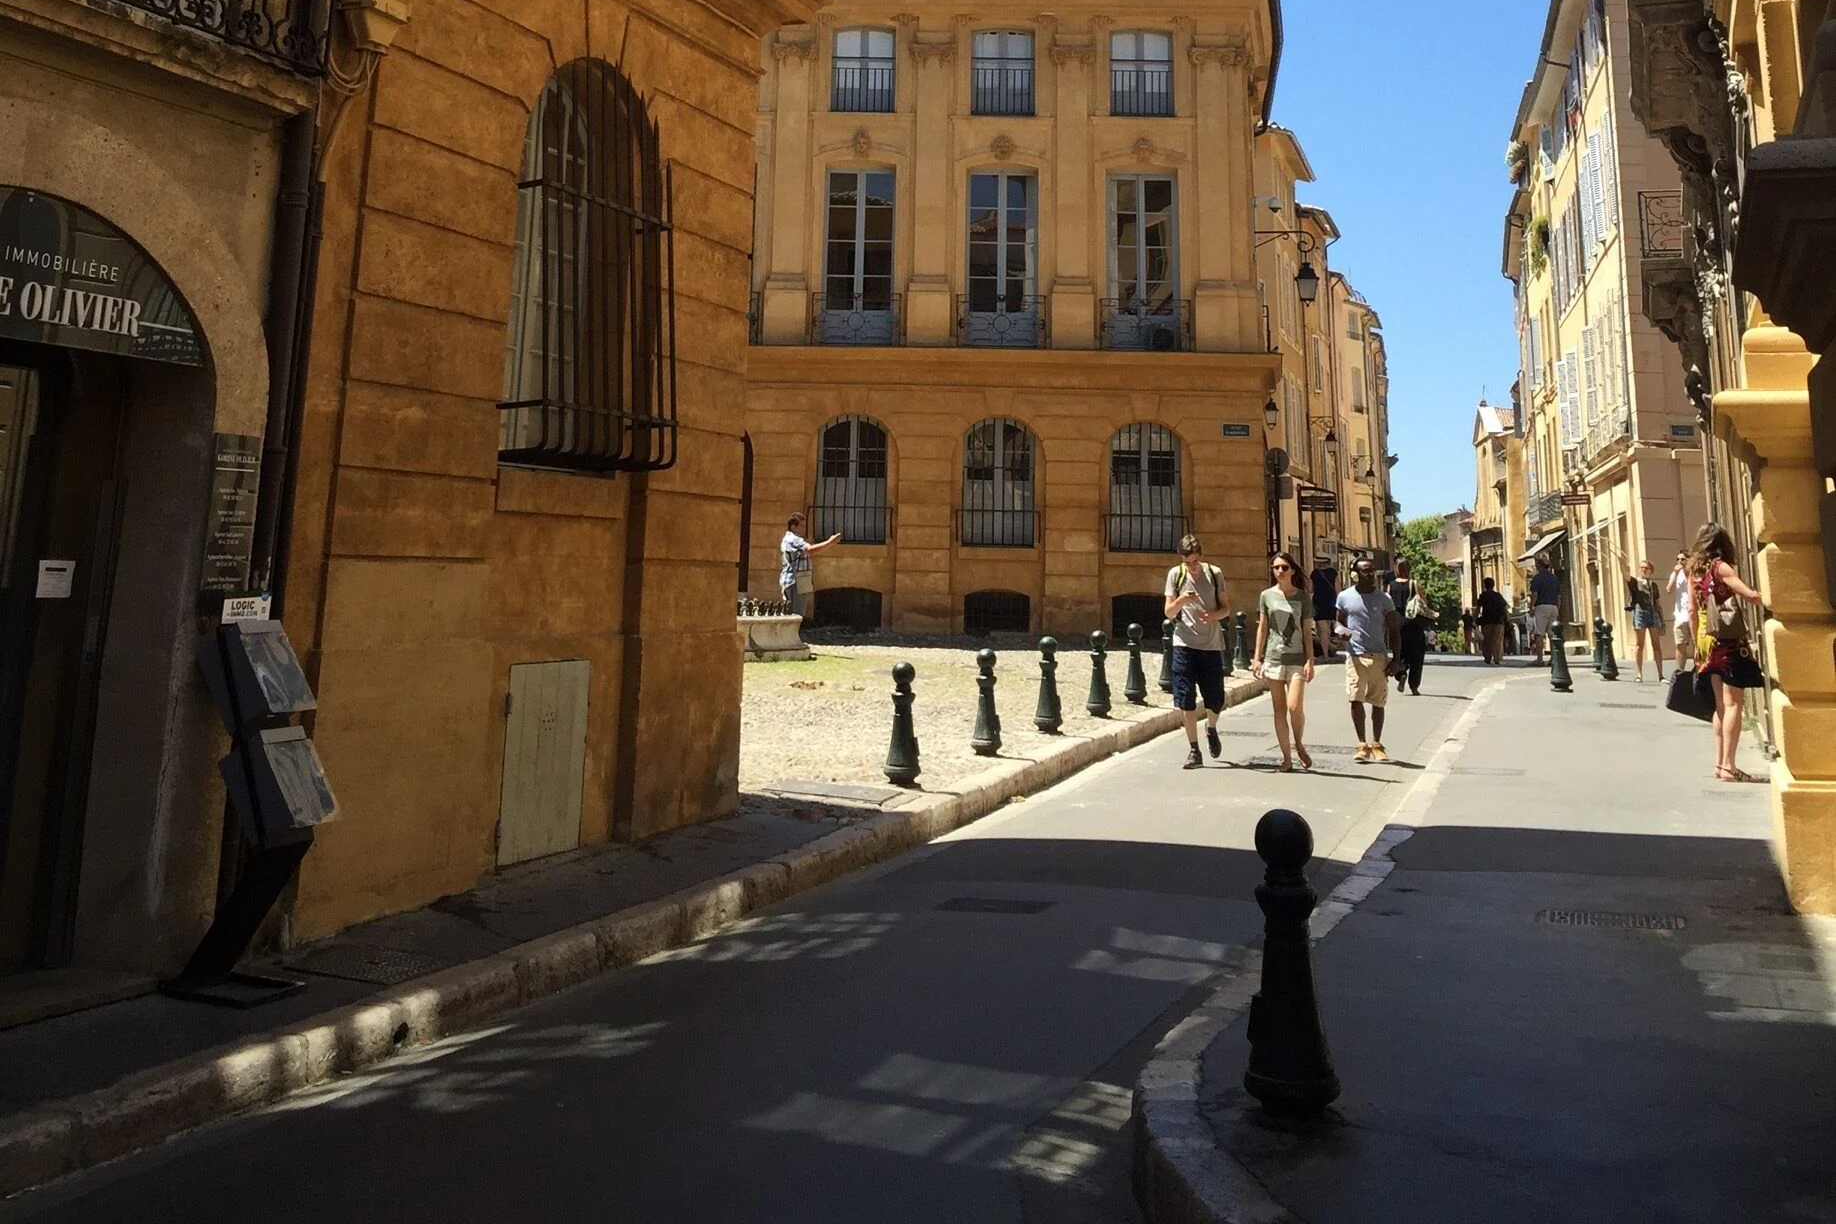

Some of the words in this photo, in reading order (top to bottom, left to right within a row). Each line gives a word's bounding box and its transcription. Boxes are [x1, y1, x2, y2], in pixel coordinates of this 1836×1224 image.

[5, 245, 119, 282] IMMOBILIÈRE
[20, 281, 141, 337] OLIVIER
[231, 600, 256, 611] LOGIC
